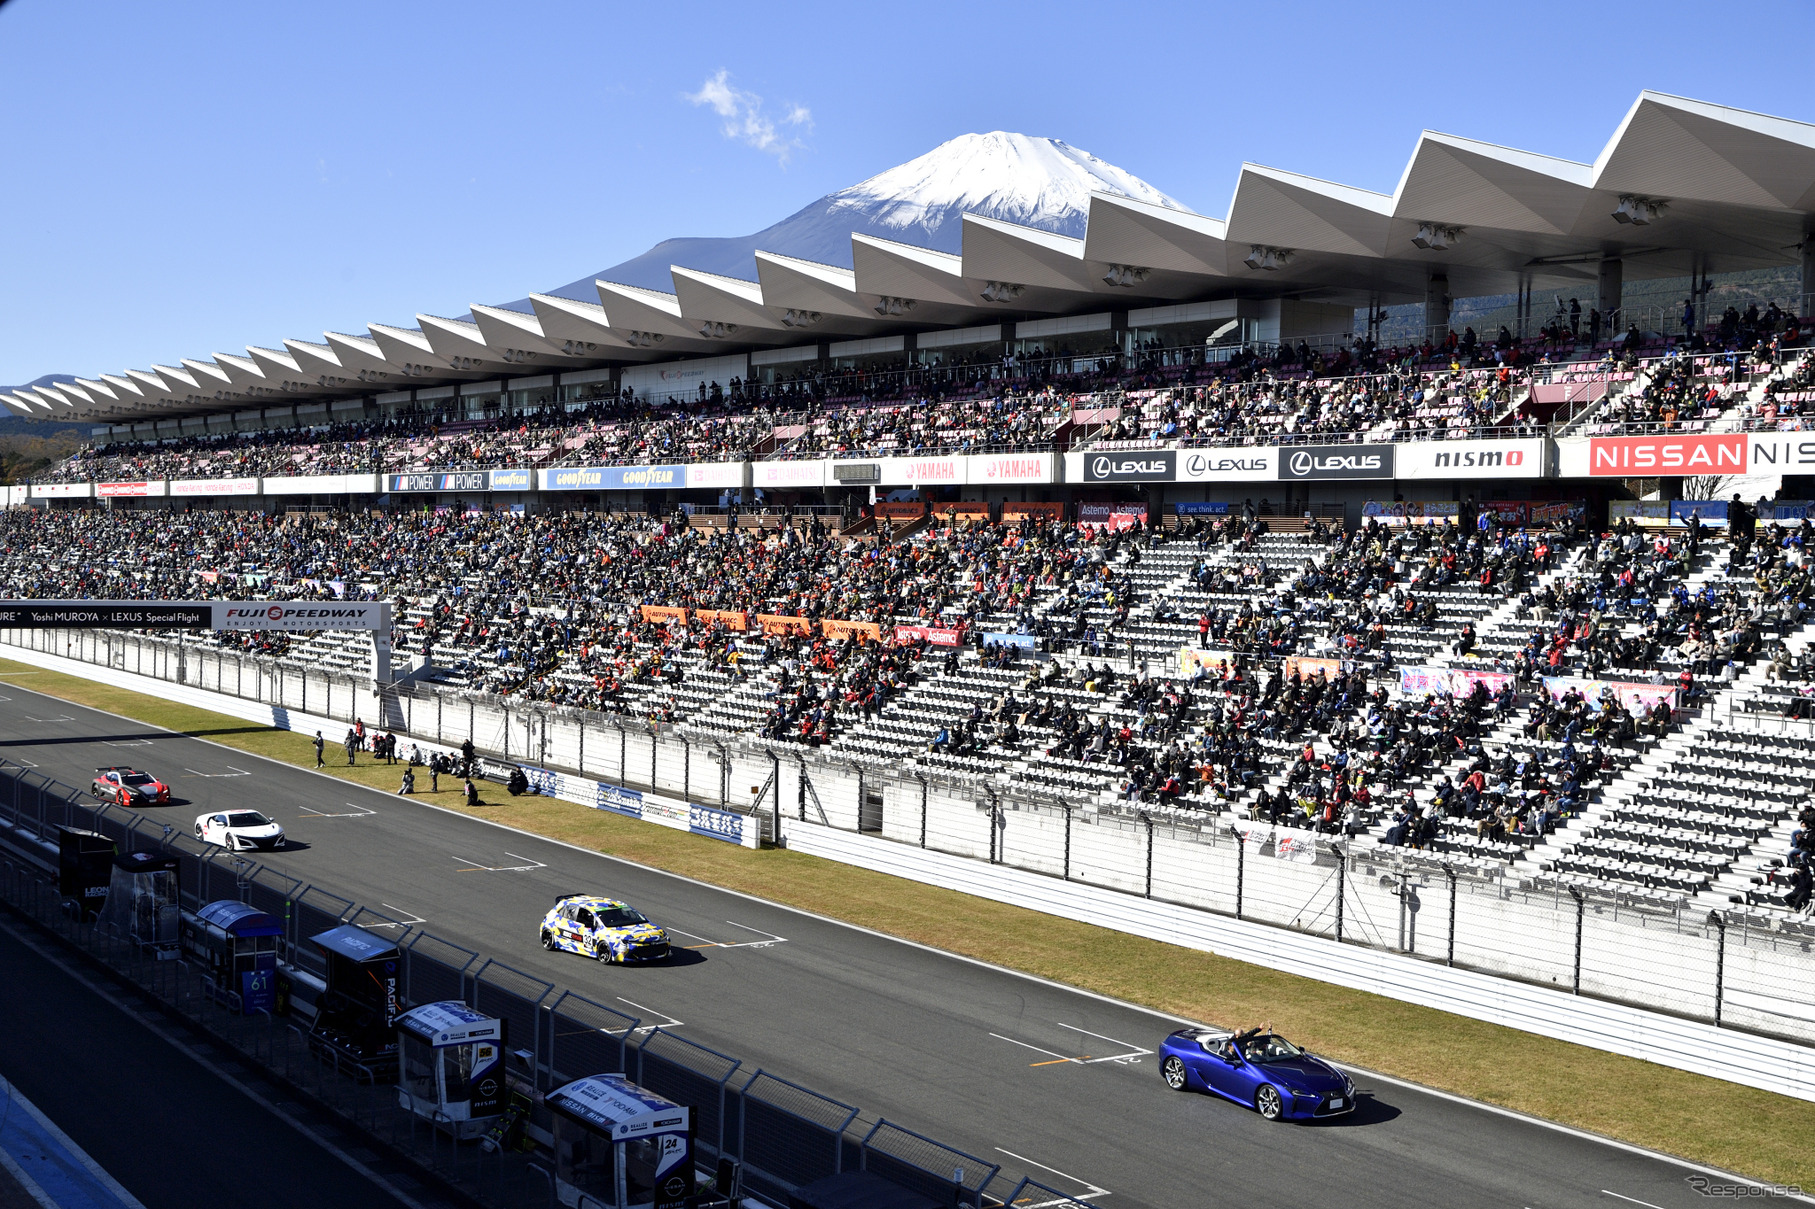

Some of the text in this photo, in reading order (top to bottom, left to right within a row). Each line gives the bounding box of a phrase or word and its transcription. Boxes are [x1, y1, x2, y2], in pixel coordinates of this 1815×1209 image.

[1565, 390, 1571, 400] F
[1434, 451, 1523, 467] nismo
[1595, 443, 1742, 468] NISSAN
[1754, 442, 1815, 464] NIS
[999, 460, 1041, 478] YAMAHA
[1112, 460, 1167, 474] LEXUS
[1208, 458, 1267, 471] LEXUS
[1313, 455, 1381, 470] LEXUS
[556, 468, 602, 488] GOODYEAR
[623, 467, 674, 487] GOODYEAR
[916, 464, 955, 479] YAMAHA
[409, 474, 434, 490] POWER
[456, 473, 483, 489] POWER
[1081, 505, 1110, 515] Astemo
[31, 612, 53, 622] Yoshi
[54, 612, 99, 622] MUROYA
[111, 612, 143, 622] LEXUS
[146, 612, 176, 624] Special
[177, 612, 200, 623] Flight
[227, 607, 368, 619] FUJI SPEEDWAY
[927, 630, 957, 644] Astemo
[584, 933, 592, 945] 32
[251, 976, 267, 991] 61
[665, 1139, 677, 1149] 24
